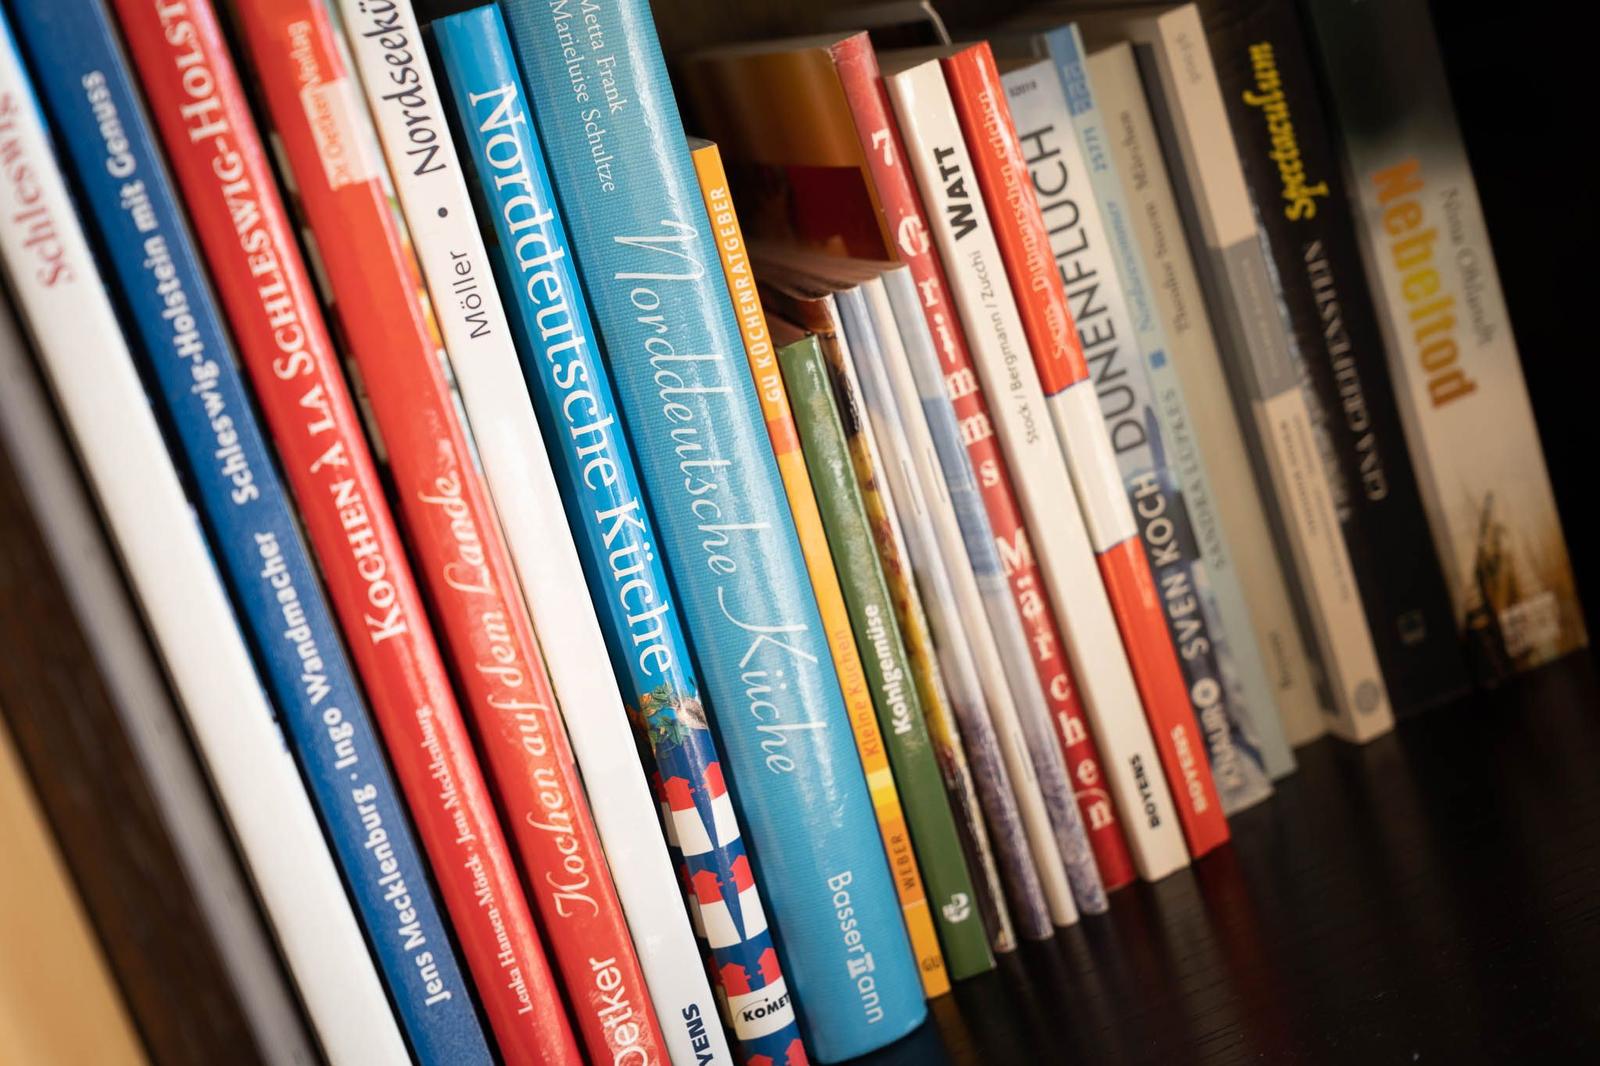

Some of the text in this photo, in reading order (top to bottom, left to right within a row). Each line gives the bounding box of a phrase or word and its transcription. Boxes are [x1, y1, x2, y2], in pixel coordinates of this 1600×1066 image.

[549, 0, 617, 193] Marieluise Schultze
[596, 54, 628, 115] Frank
[871, 127, 894, 167] 7
[1242, 41, 1329, 221] Spectaculum
[155, 0, 314, 380] SCHLESWIG-HOLST
[933, 146, 978, 240] WATT
[82, 70, 260, 505] Schleswig-Holstein mit Genuss
[450, 251, 492, 341] Möller
[710, 186, 782, 403] GU KÜCHENRATGEBER
[969, 250, 995, 300] Zucchi
[1370, 154, 1479, 410] Nebeltod
[469, 80, 674, 677] Norddeutsche Küche
[991, 311, 1024, 391] Bergmann
[299, 382, 337, 437] LA
[1019, 404, 1040, 444] Stock
[614, 219, 828, 776] Norddeutsche Küche
[329, 478, 409, 647] KOCHEN
[1131, 470, 1210, 662] SVEN KOCH
[476, 611, 524, 688] dem
[865, 604, 912, 735] Kohlgemüse
[254, 531, 452, 1007] Jens Mecklenburg Ingo Wandmacher
[487, 693, 550, 757] auf
[855, 701, 881, 757] Kleine
[1170, 724, 1207, 814] BOYENS
[456, 812, 477, 843] Jens
[1130, 754, 1161, 828] BOYENS
[526, 766, 599, 918] Kochen
[891, 833, 916, 890] WEBER
[507, 969, 534, 1016] Lenka
